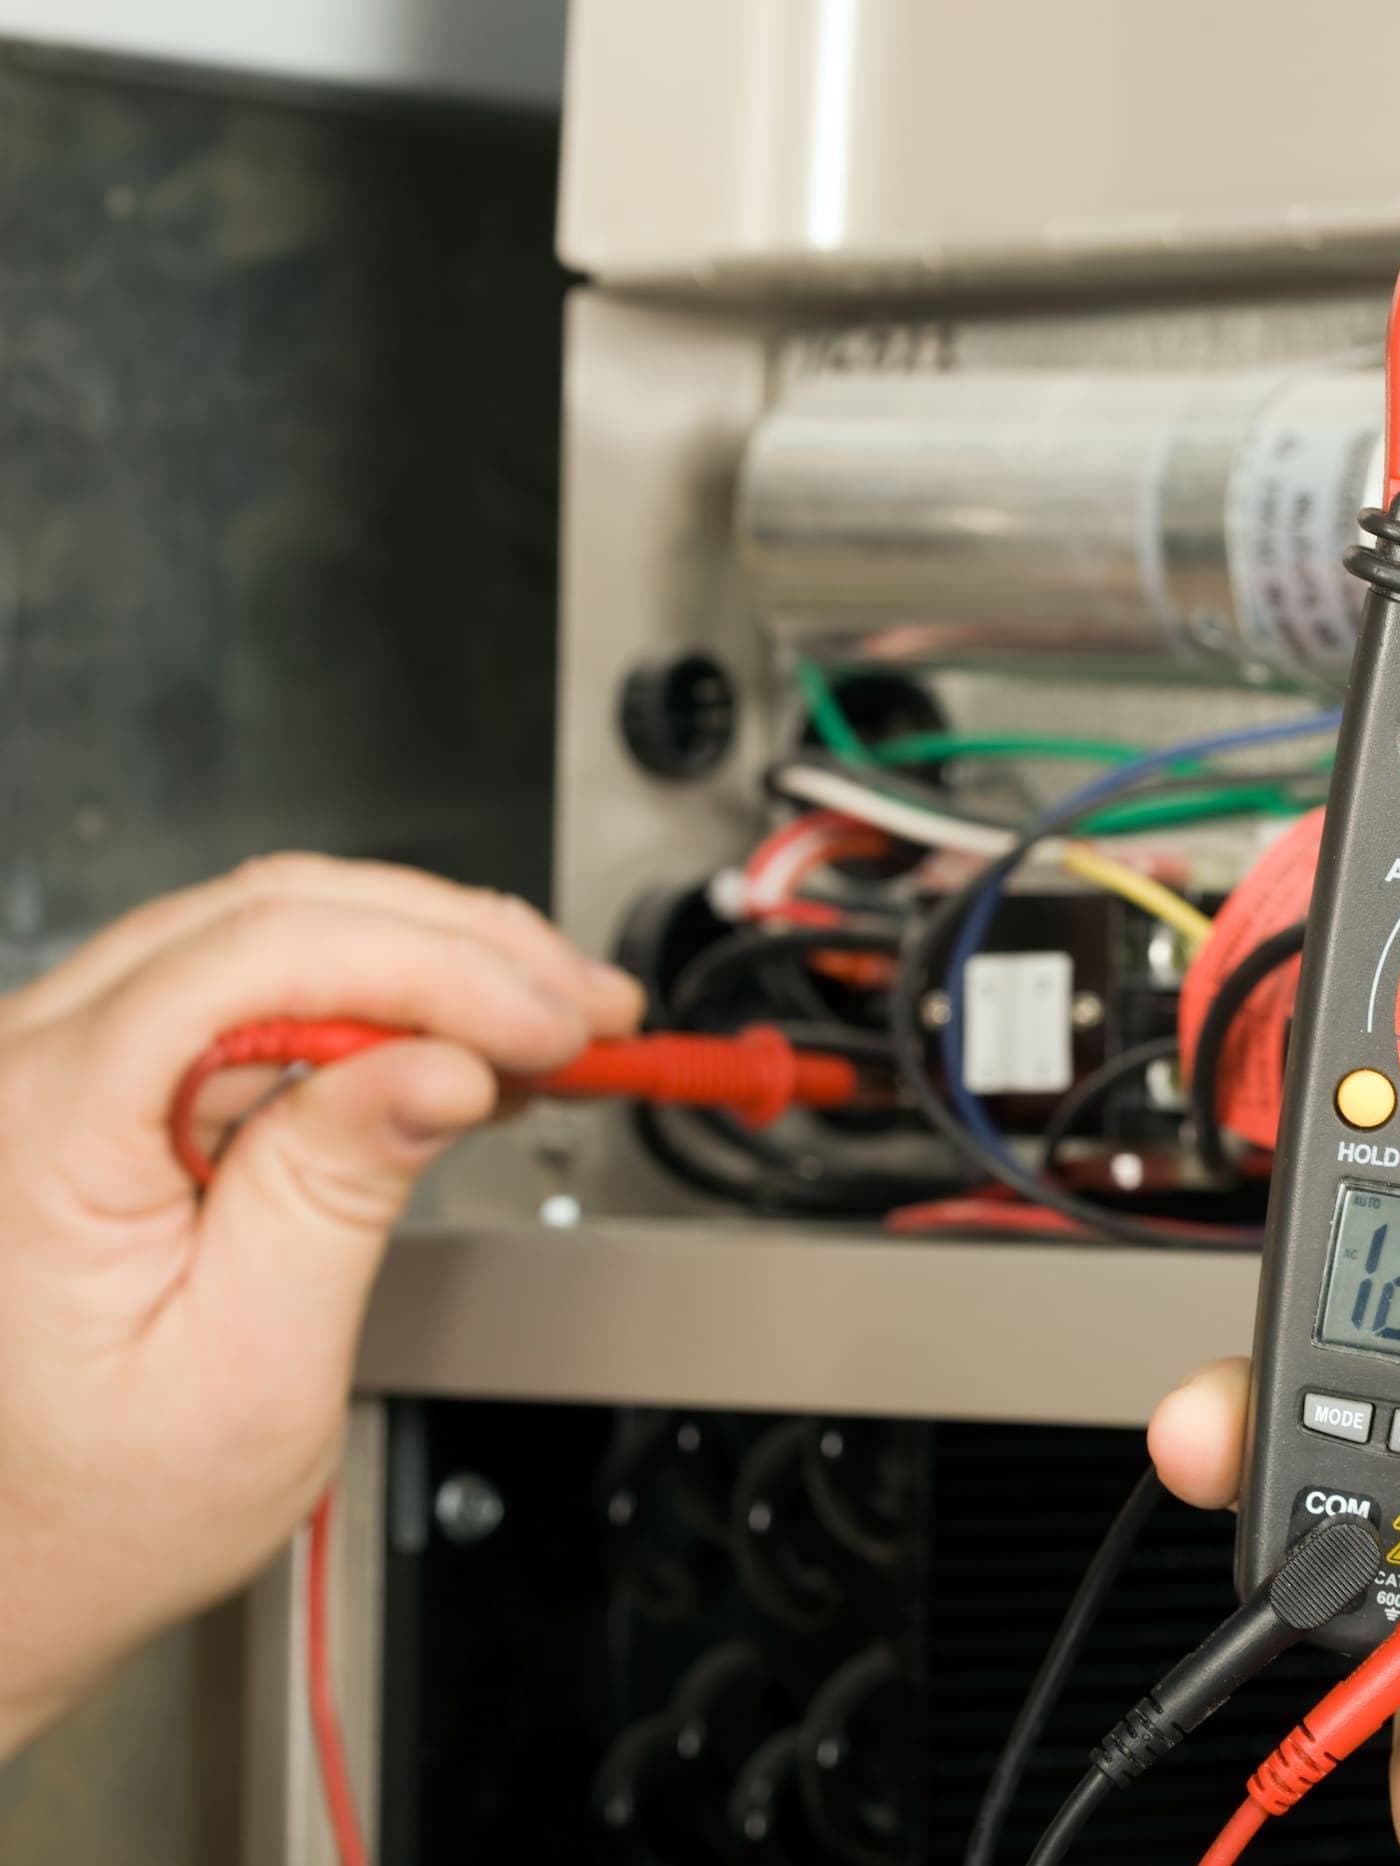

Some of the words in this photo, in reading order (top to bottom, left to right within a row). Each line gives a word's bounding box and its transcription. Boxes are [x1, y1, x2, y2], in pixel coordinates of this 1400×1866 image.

[1337, 1141, 1400, 1168] HOLD
[1314, 1406, 1365, 1430] MODE
[1305, 1491, 1371, 1520] COM
